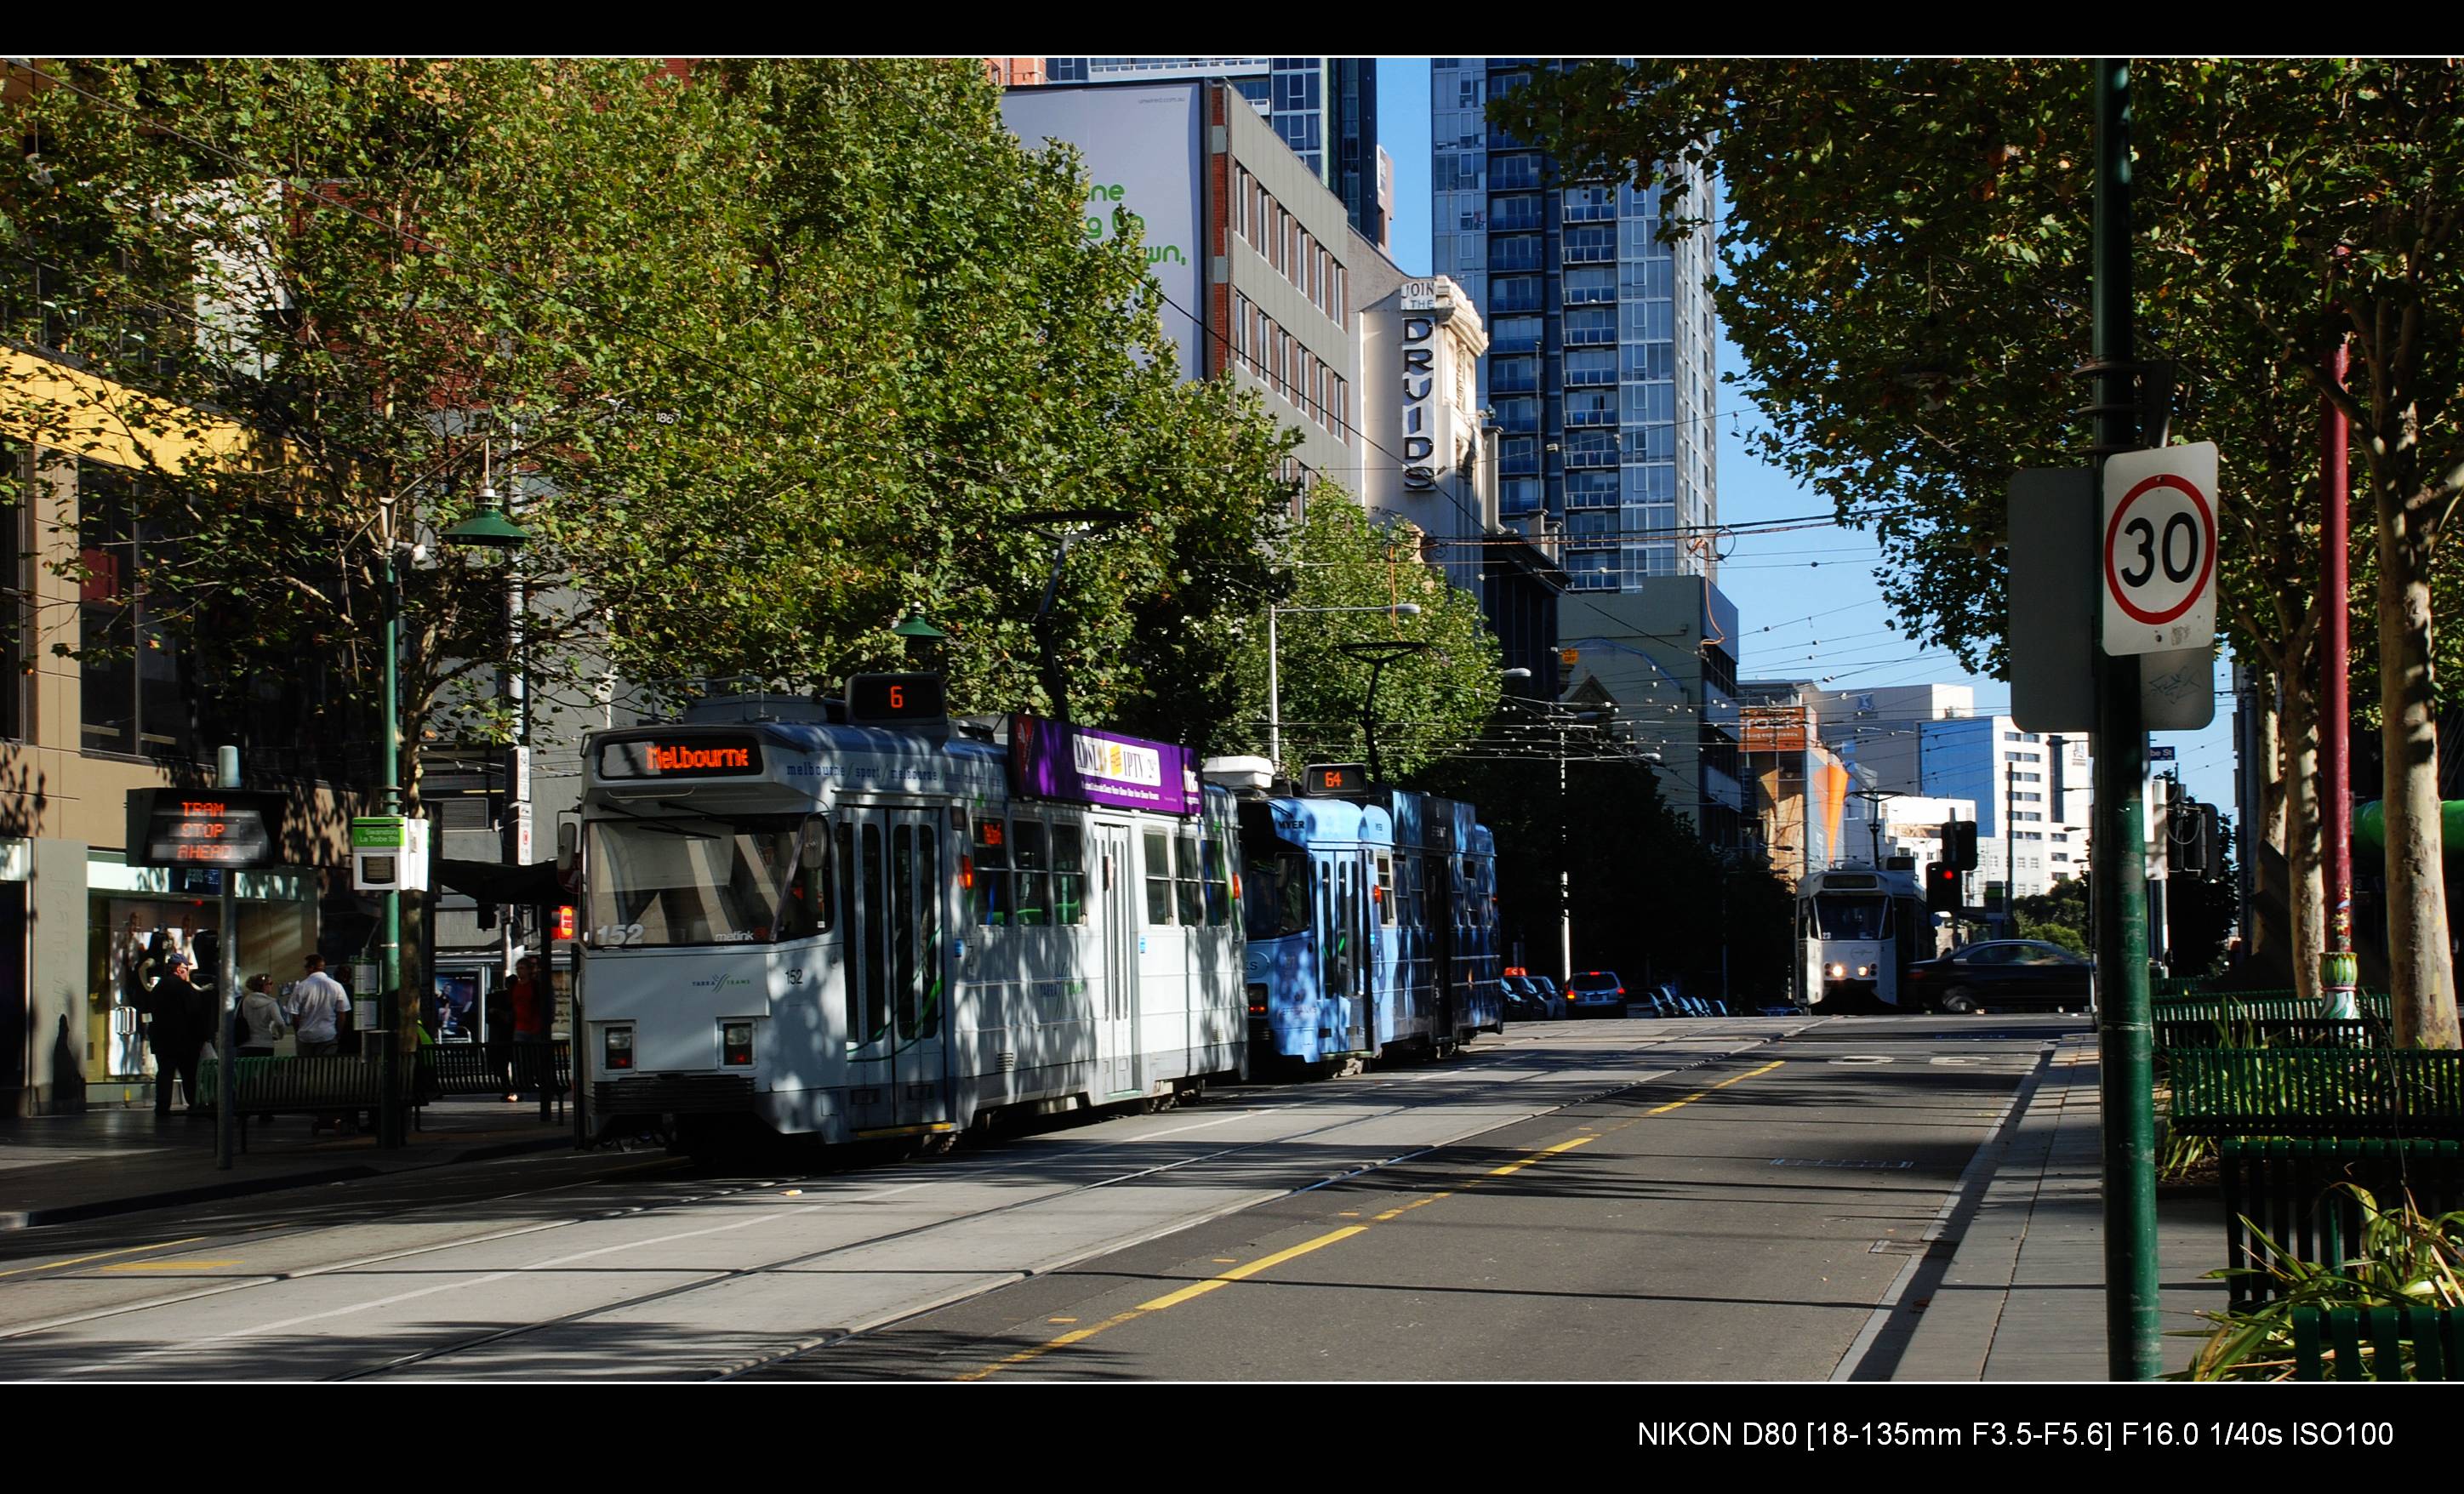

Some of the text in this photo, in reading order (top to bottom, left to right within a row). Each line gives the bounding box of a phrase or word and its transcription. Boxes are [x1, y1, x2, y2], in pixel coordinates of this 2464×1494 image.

[1401, 282, 1434, 299] JOIN
[1410, 299, 1434, 309] THE
[1404, 318, 1434, 489] DRUIDS
[2120, 512, 2199, 587] 30
[890, 686, 904, 708] 6
[856, 768, 881, 780] sport
[1325, 772, 1342, 788] 64
[181, 802, 225, 817] TRAM
[181, 823, 225, 837] STOP
[1278, 820, 1305, 830] MYER
[177, 844, 232, 858] AHEAD
[598, 921, 645, 945] 152
[716, 929, 755, 942] metlink
[784, 968, 803, 985] 152
